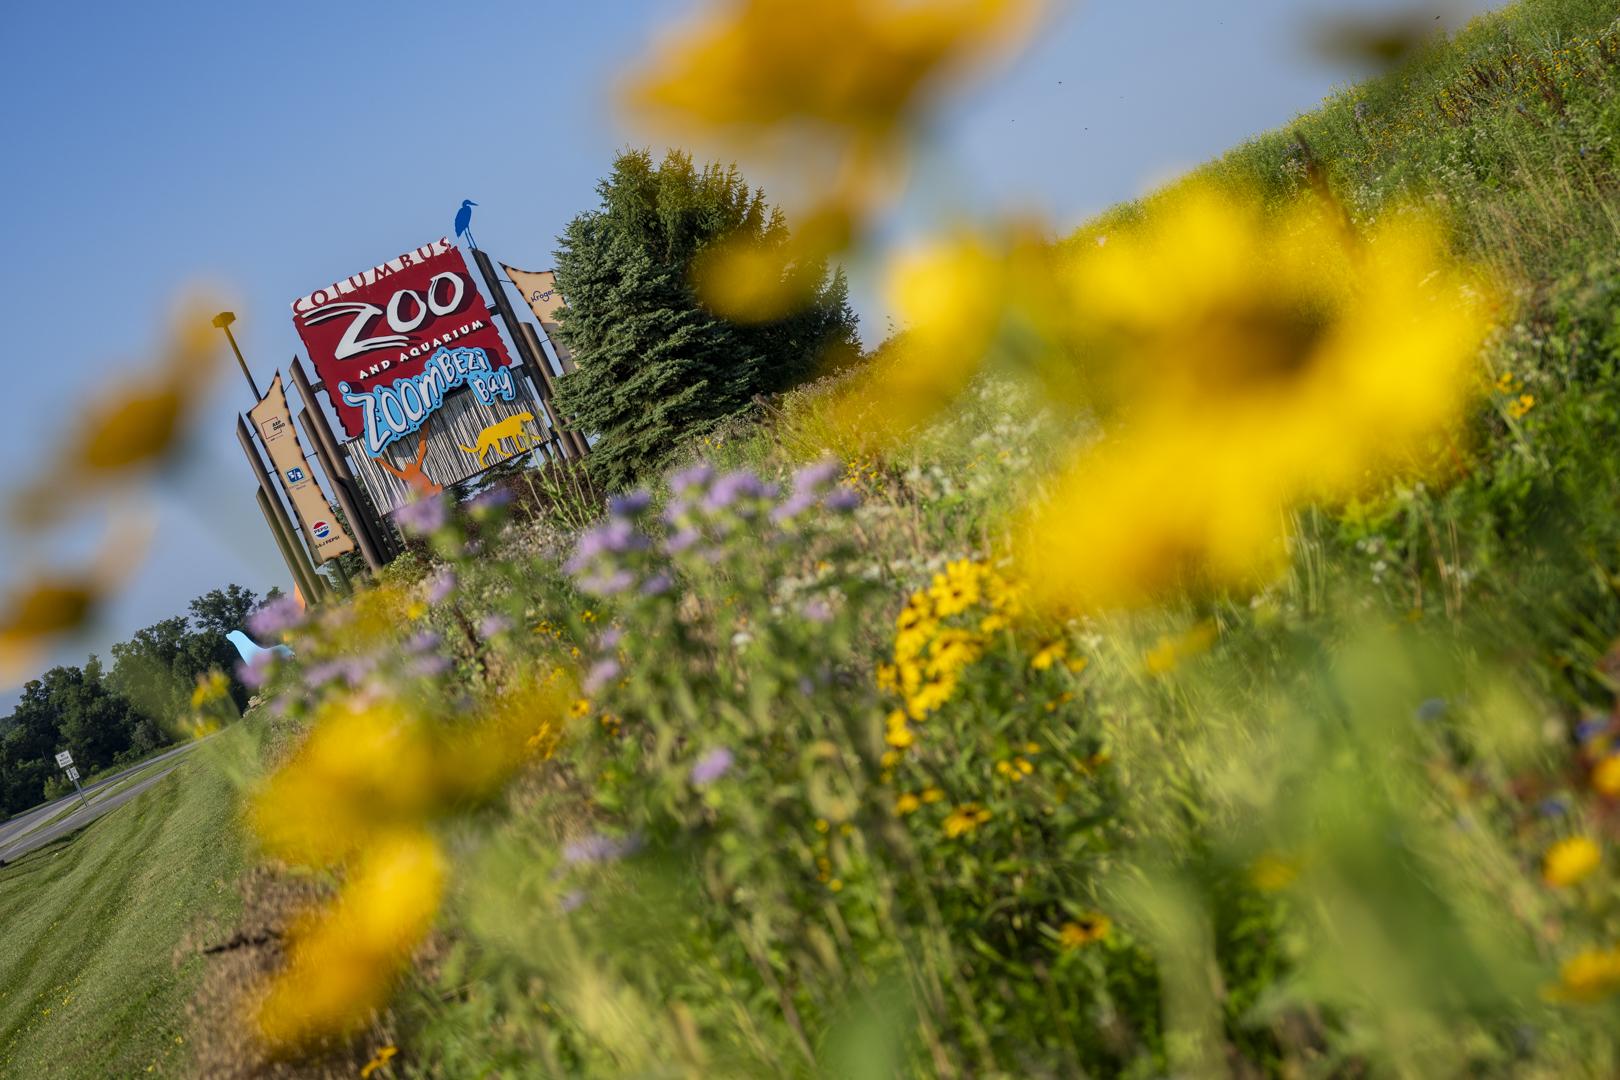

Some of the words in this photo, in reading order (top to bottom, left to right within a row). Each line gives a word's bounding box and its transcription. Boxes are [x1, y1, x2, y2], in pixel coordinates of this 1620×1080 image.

[293, 236, 452, 314] COLUMBUS
[530, 290, 554, 302] Kroger
[301, 271, 465, 361] ZOO
[359, 358, 391, 380] AND
[399, 319, 484, 362] AQUARIUM
